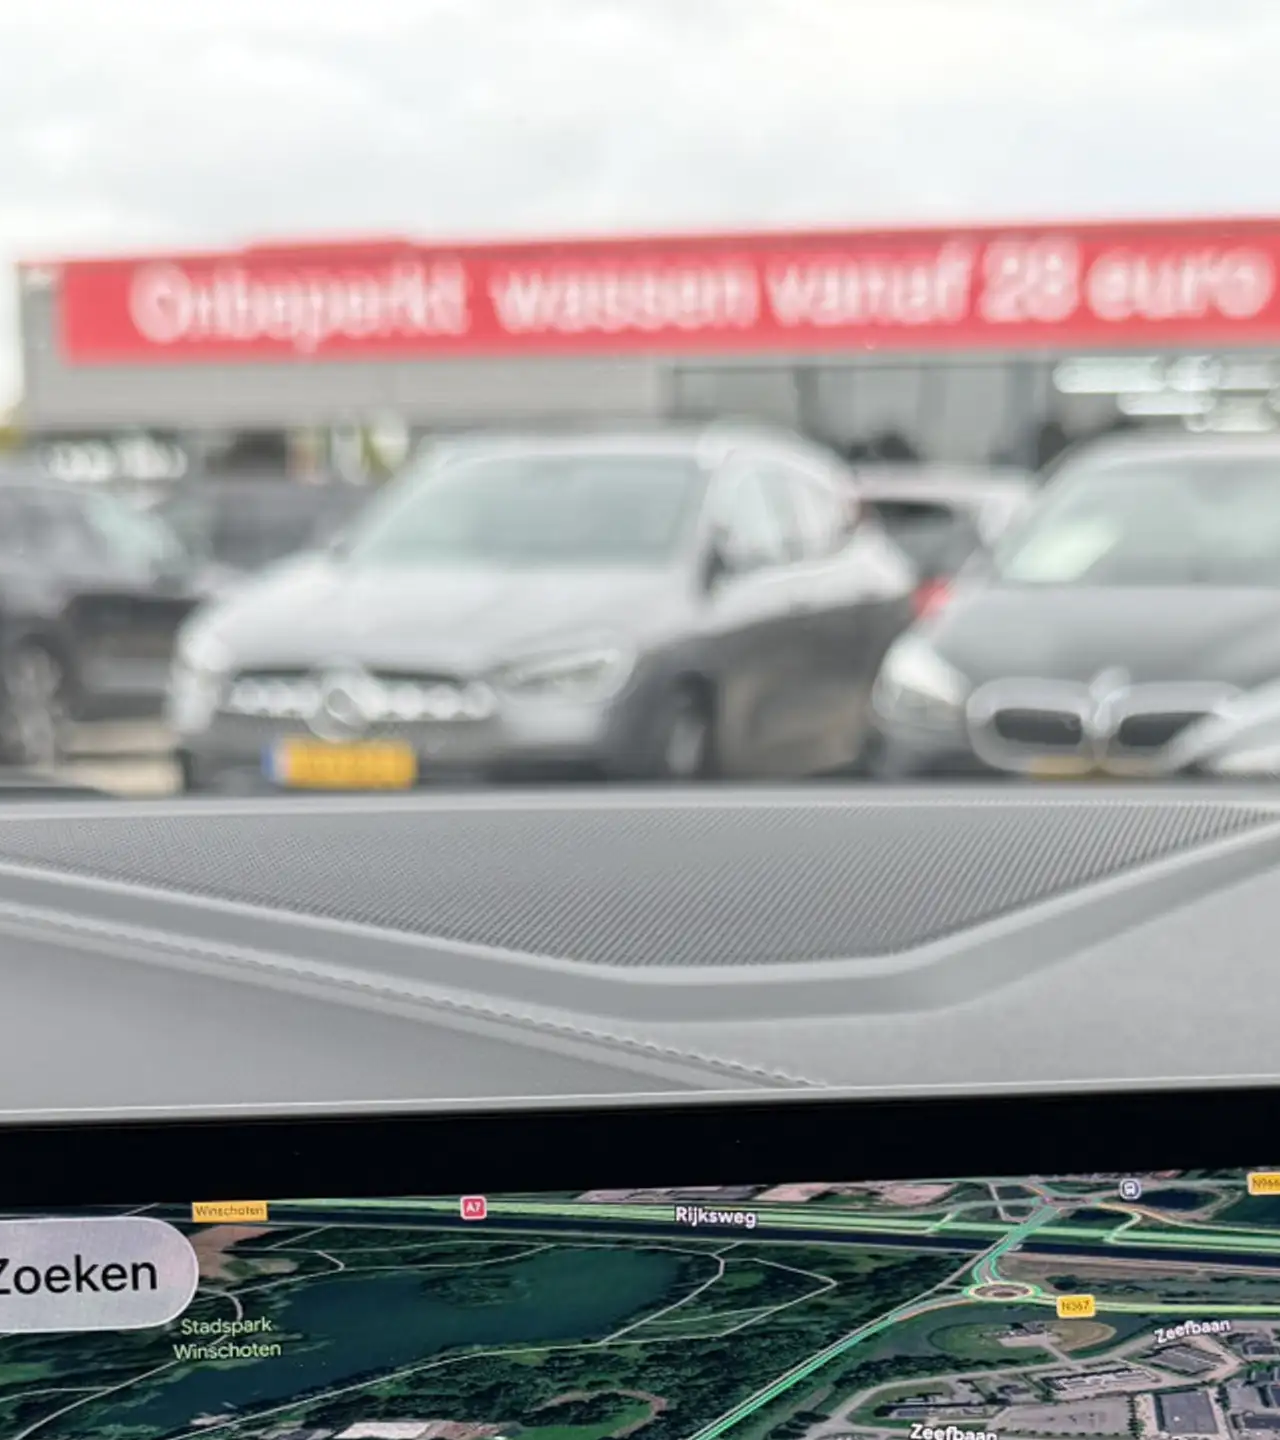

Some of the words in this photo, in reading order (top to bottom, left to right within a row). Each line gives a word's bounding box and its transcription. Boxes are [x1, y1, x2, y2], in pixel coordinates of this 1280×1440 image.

[1087, 248, 1275, 320] euro
[465, 1201, 481, 1214] A7
[675, 1207, 758, 1229] Rijksweg
[180, 1316, 273, 1337] Stadspark
[1153, 1320, 1232, 1344] Zeefbaan
[173, 1342, 282, 1361] Winschoten
